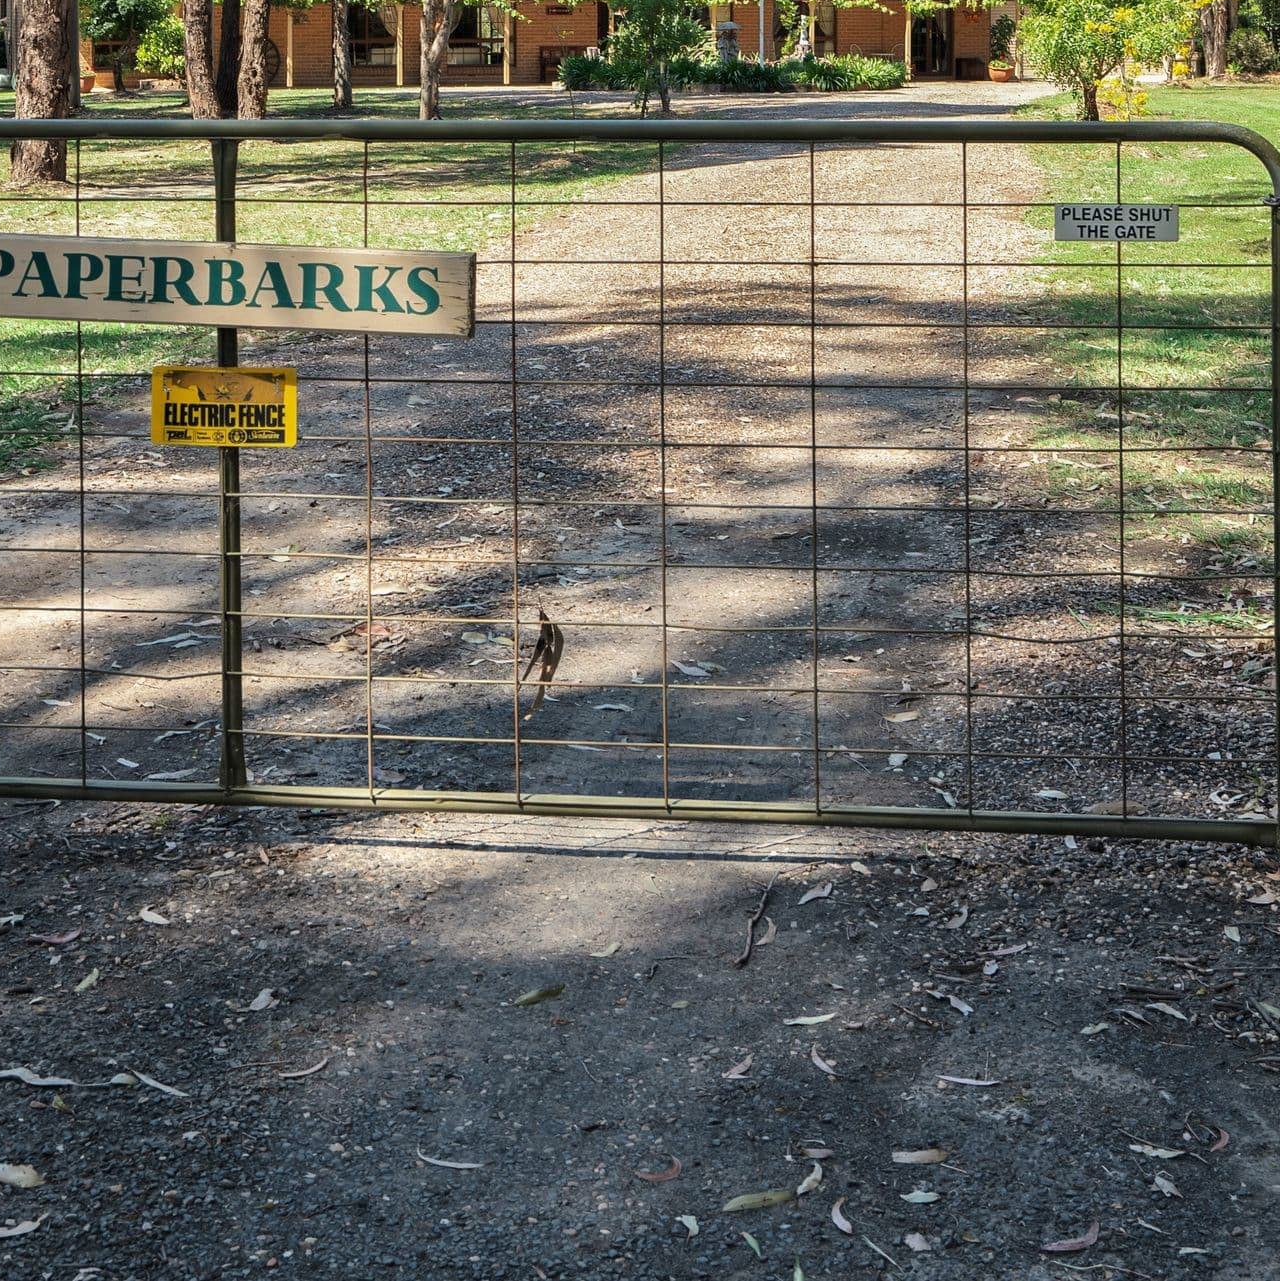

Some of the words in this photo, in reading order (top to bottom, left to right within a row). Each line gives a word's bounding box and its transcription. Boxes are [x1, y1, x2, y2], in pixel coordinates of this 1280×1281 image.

[1062, 207, 1123, 221] PLEASE
[1129, 208, 1171, 222] SHUT
[1077, 225, 1109, 239] THE
[1114, 226, 1156, 239] GATE
[165, 403, 237, 427] ELECTRIC
[238, 405, 285, 427] FENCE
